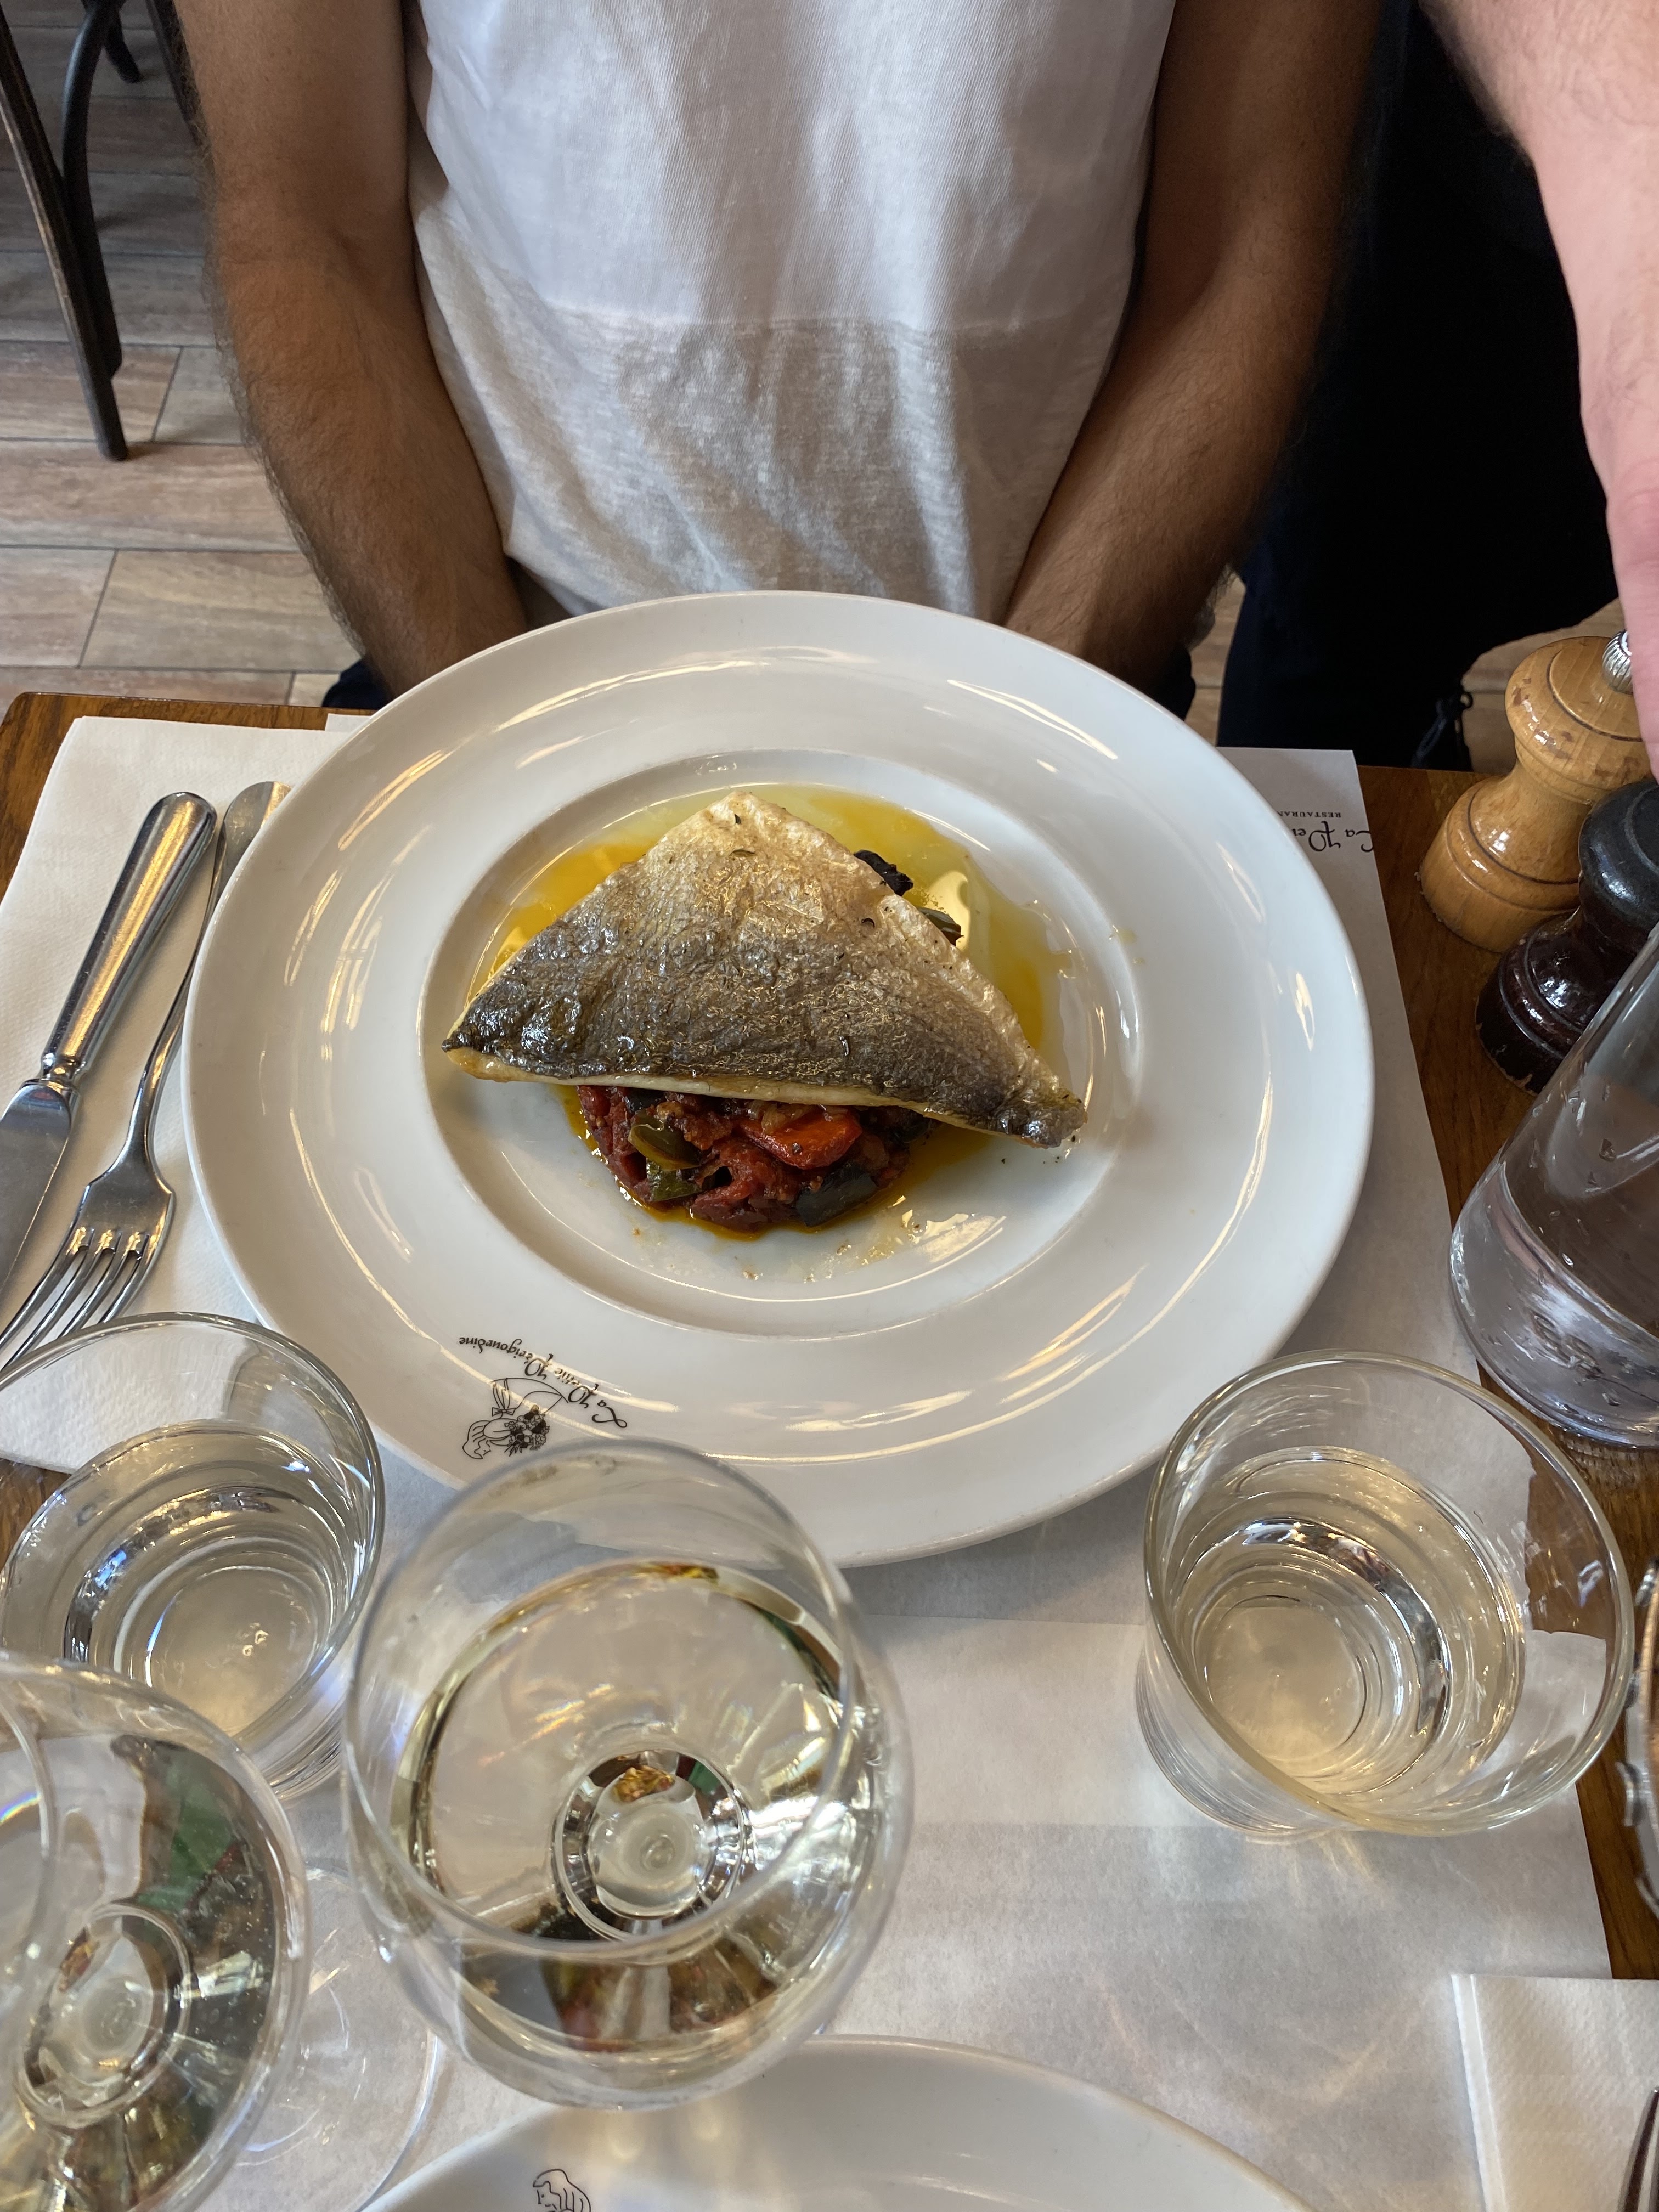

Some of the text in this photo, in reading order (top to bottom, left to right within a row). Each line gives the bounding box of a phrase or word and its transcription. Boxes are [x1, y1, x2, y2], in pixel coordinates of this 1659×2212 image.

[458, 1336, 628, 1428] La Petite Périgourdine
